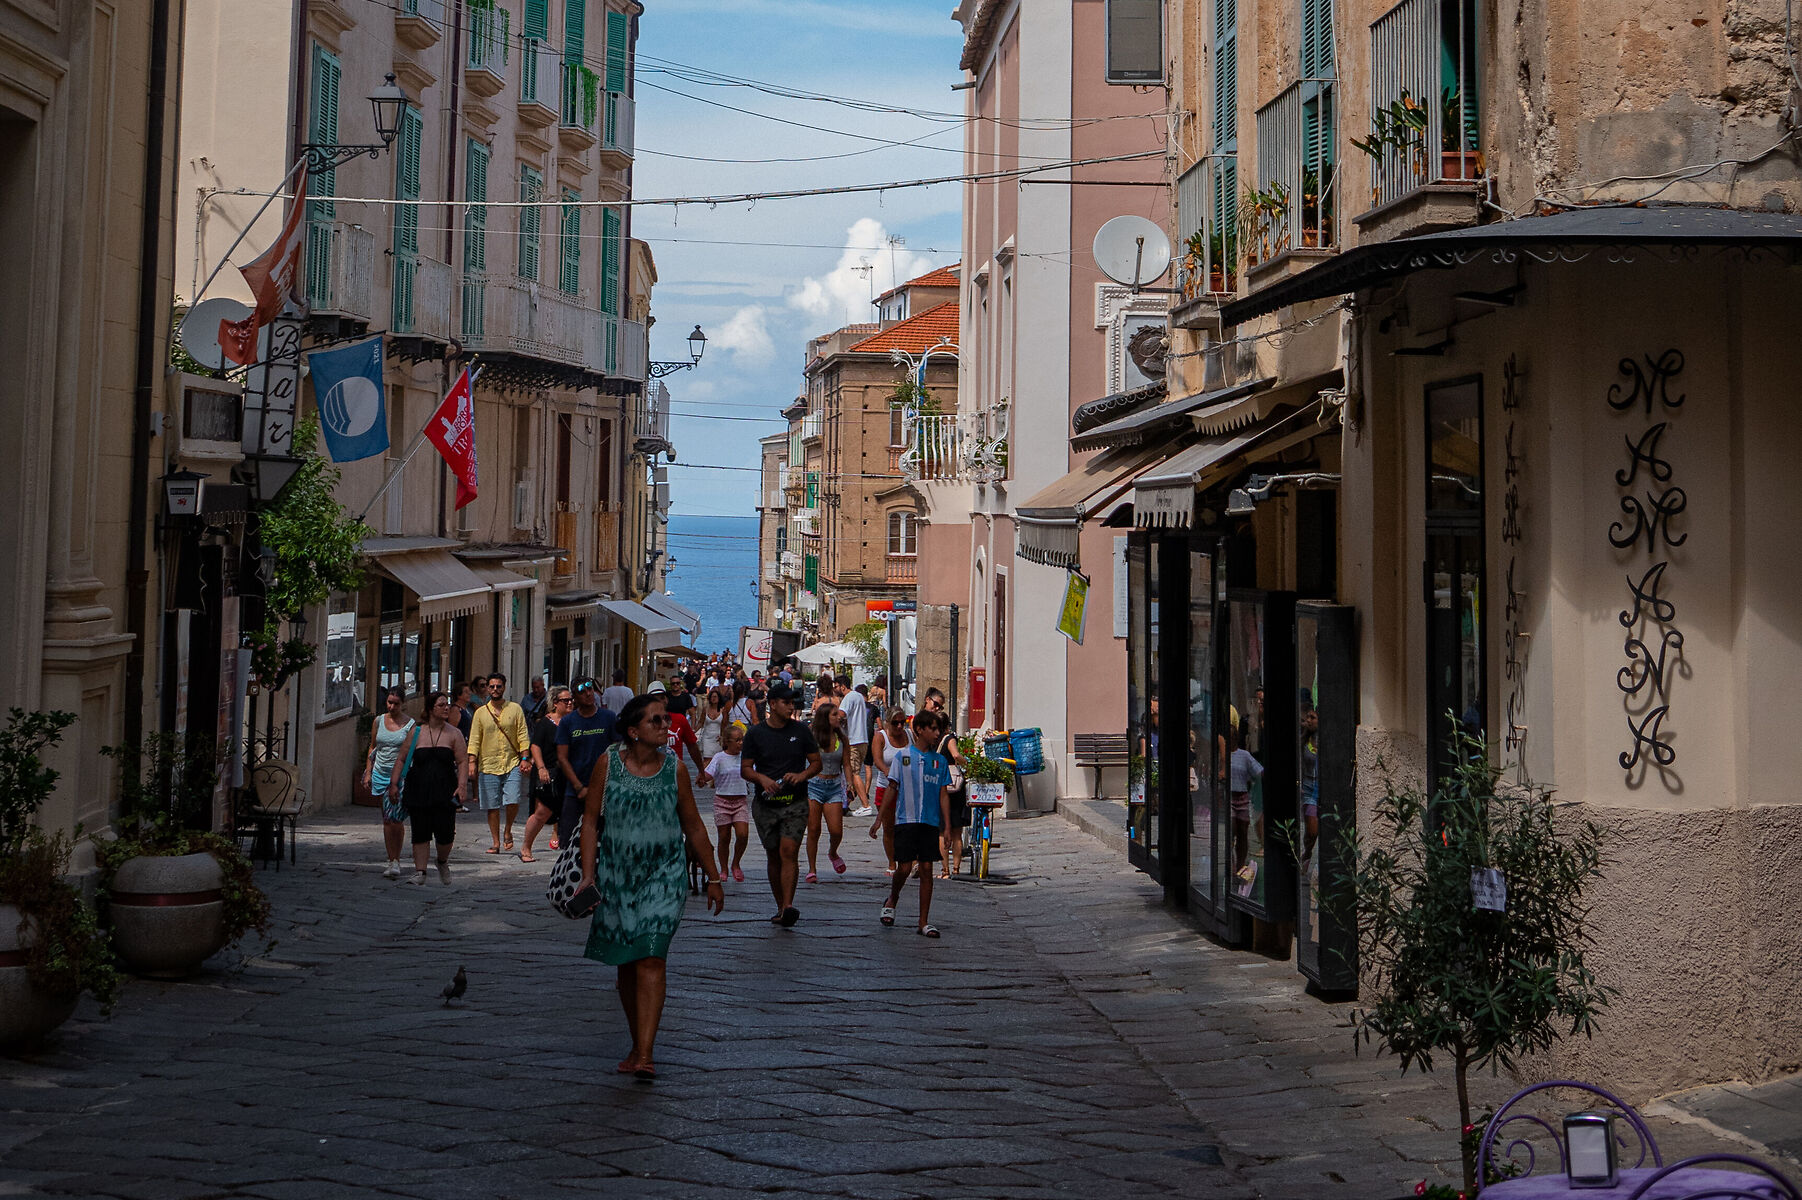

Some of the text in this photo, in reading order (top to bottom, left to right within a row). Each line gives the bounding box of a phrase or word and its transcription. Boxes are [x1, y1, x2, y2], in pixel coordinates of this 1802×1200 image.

[267, 324, 300, 444] Bar
[1607, 348, 1688, 770] MAMANA
[976, 793, 997, 801] 2022
